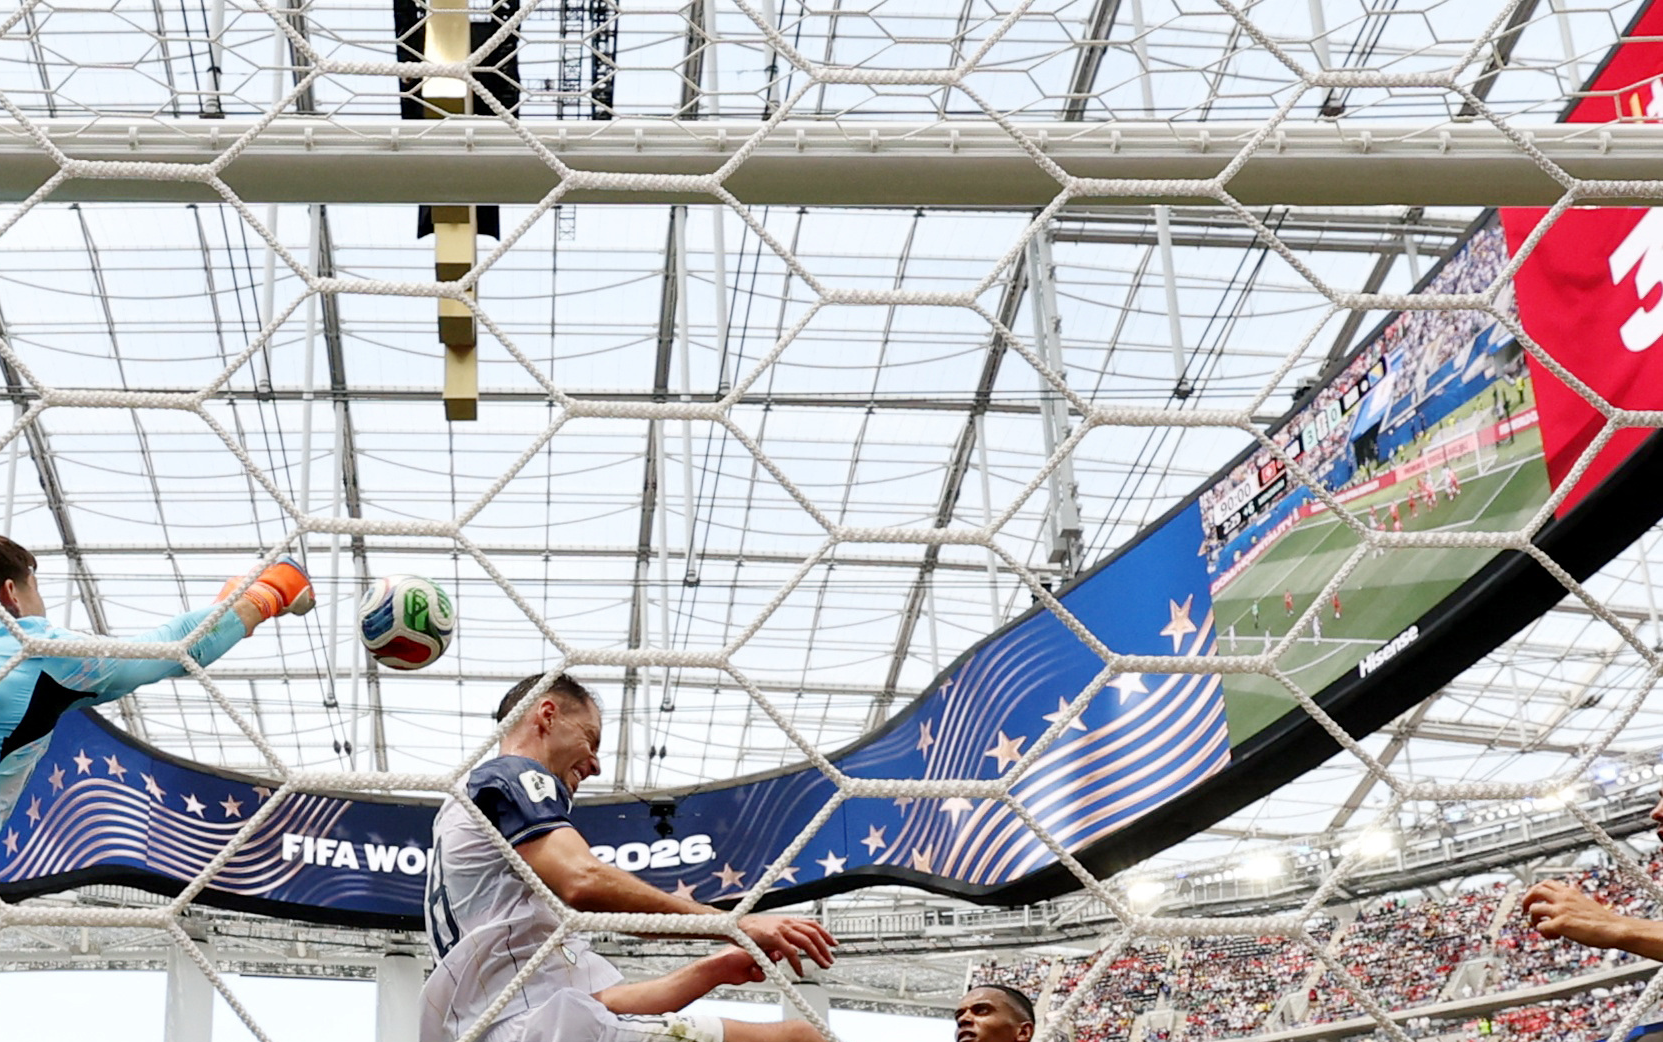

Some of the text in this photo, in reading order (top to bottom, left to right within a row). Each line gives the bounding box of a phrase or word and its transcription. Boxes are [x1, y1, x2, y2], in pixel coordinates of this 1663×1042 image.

[1220, 482, 1251, 517] 90:00
[1358, 623, 1420, 679] Hisense
[282, 832, 359, 870] FIFA
